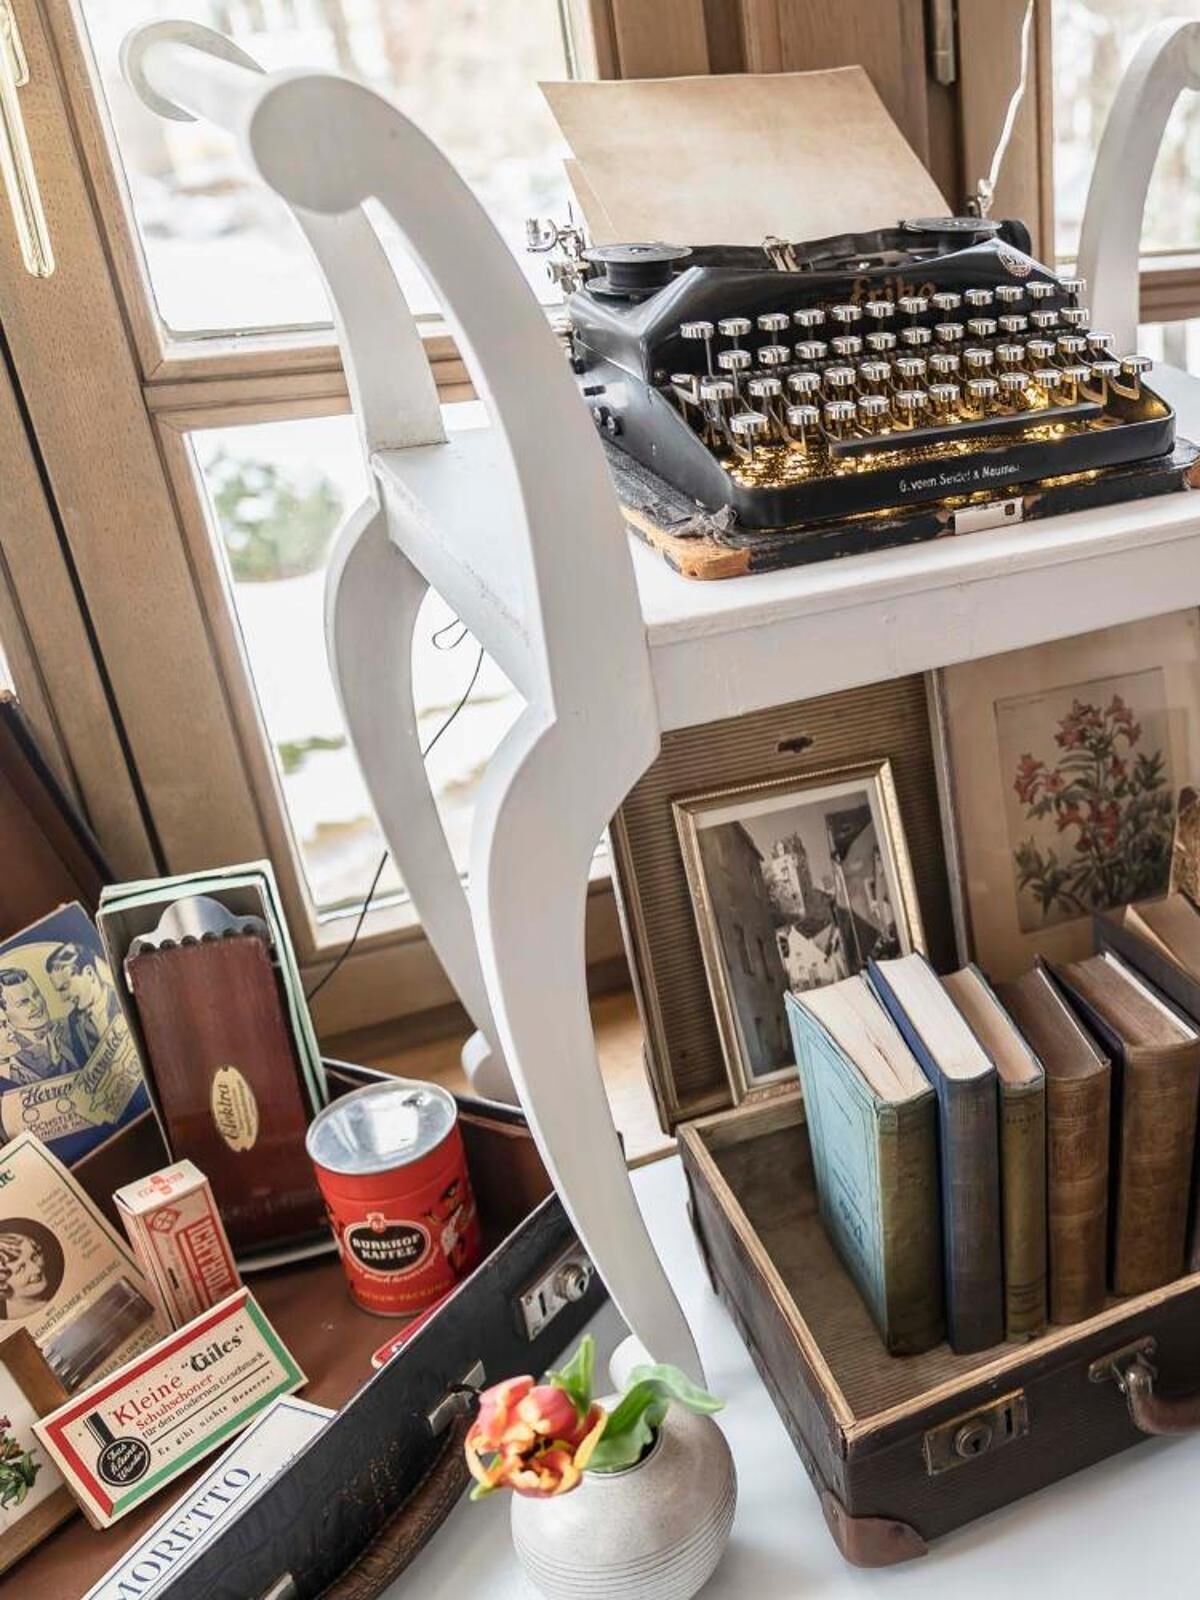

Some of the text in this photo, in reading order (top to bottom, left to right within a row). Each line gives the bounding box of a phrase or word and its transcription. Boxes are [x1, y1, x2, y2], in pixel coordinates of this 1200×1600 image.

[217, 1083, 240, 1139] Elektra
[352, 1233, 421, 1250] BURKHOF
[361, 1246, 417, 1260] KAFFEE
[111, 1374, 183, 1427] Kleine
[142, 1352, 265, 1440] für den modernen Geschmack
[175, 1427, 195, 1446] gibt
[199, 1404, 228, 1427] nichts
